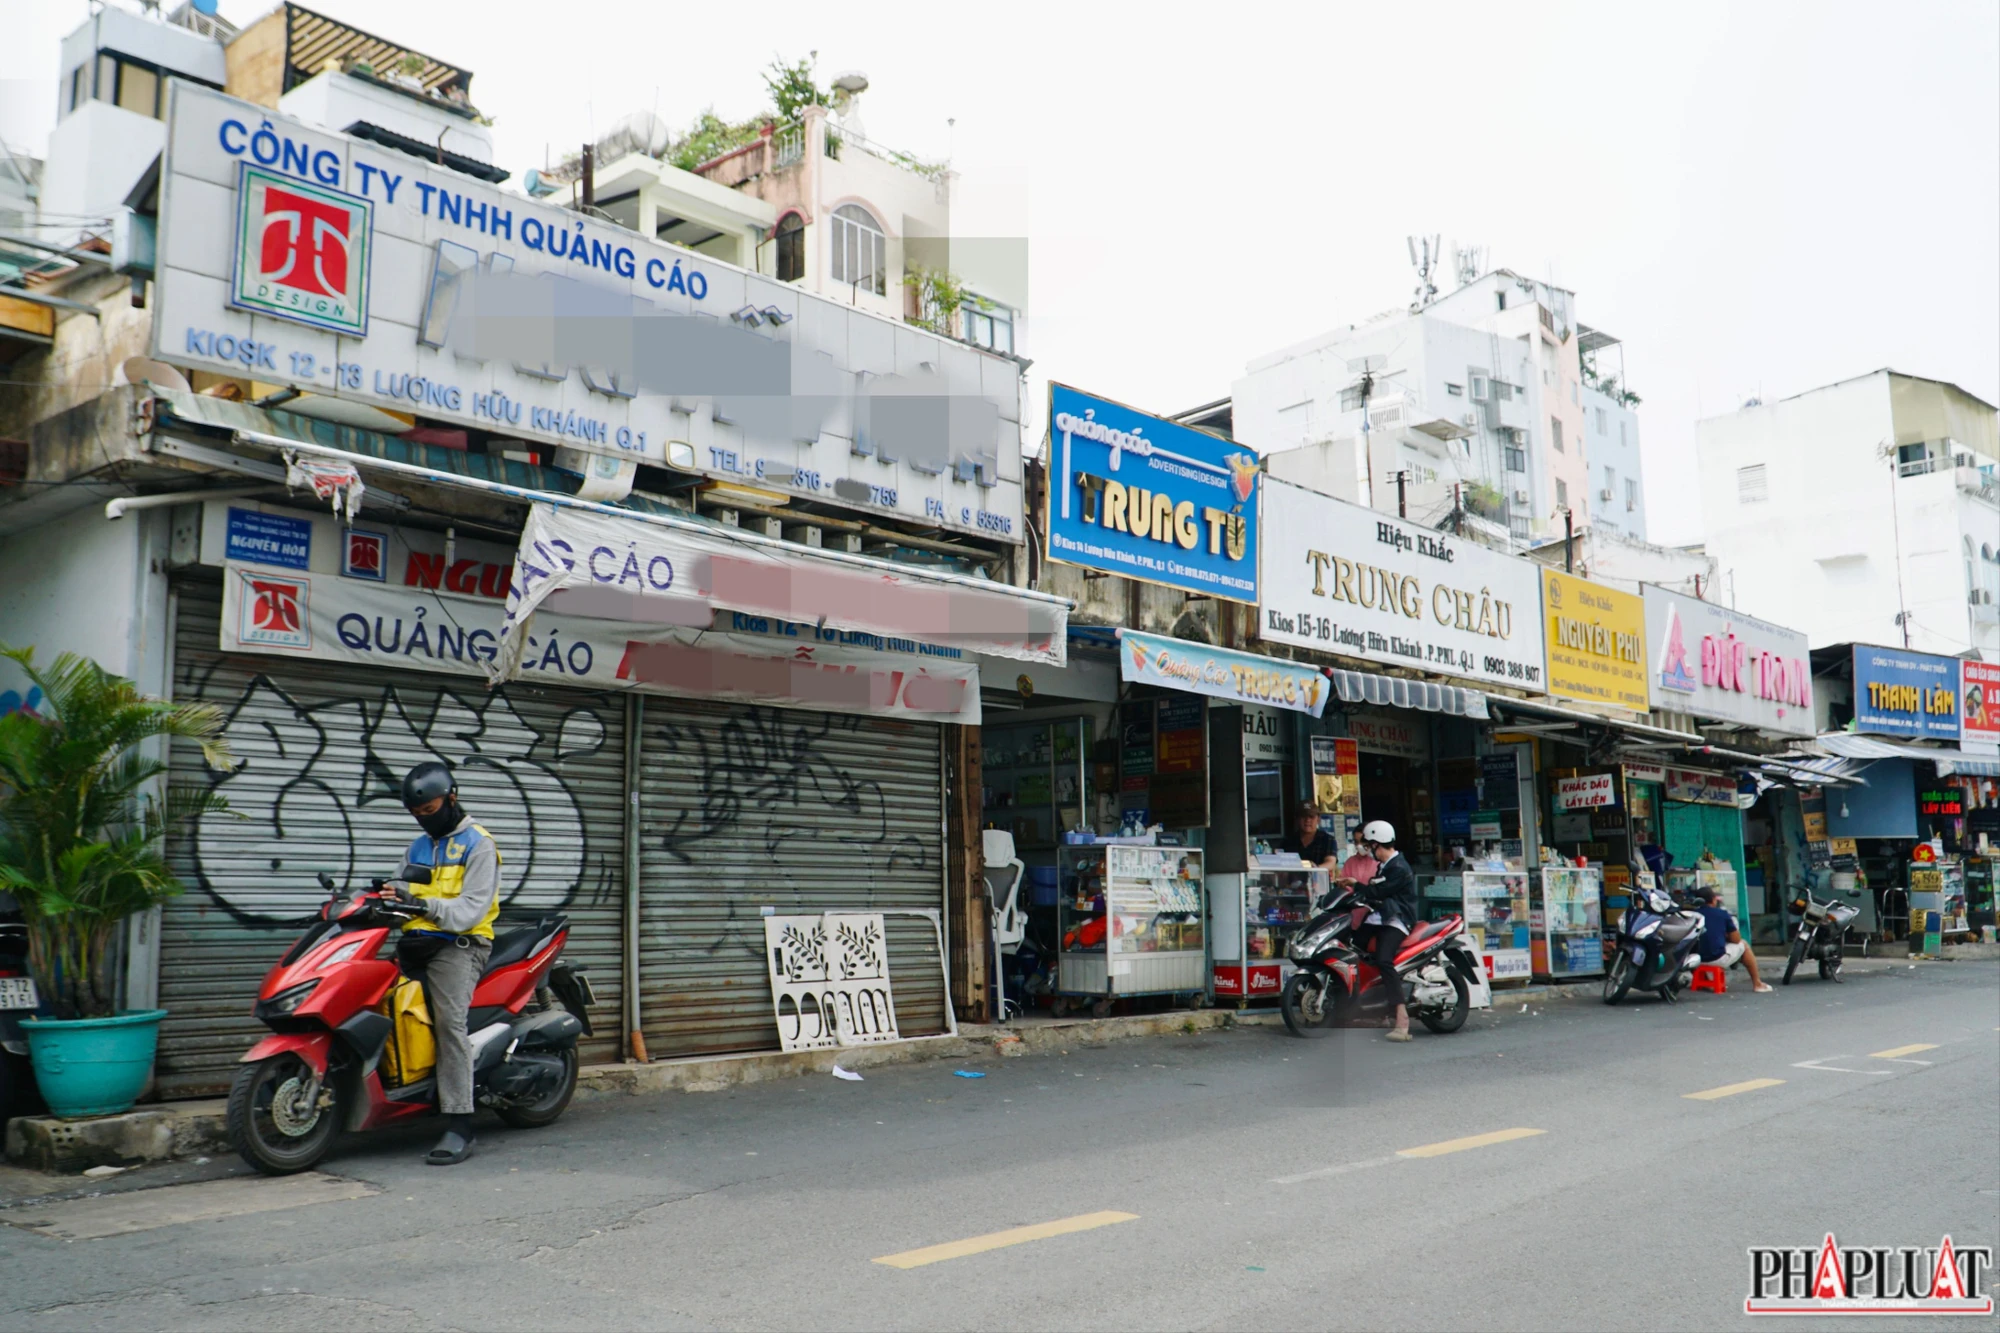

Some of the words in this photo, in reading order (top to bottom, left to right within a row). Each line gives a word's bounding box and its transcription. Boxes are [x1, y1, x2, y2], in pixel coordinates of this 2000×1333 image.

[218, 118, 340, 186] CÔNG
[354, 161, 404, 204] TY
[414, 181, 513, 241] TNHH
[520, 220, 636, 281] QUẢNG
[645, 257, 709, 301] CÁO
[256, 283, 347, 318] DESIGN
[185, 326, 277, 370] KIOSK
[288, 350, 316, 379] 12
[337, 361, 364, 389] 13
[374, 368, 462, 411] LƯƠNG
[472, 388, 523, 424] HỮU
[530, 407, 609, 444] KHÁNH
[616, 425, 649, 453] Q.1
[1076, 470, 1199, 551] TRUNG
[1202, 503, 1247, 562] TÚ
[1376, 521, 1413, 554] Hiệu
[1416, 535, 1455, 564] Khắc
[588, 541, 674, 594] CÁO
[1306, 548, 1424, 621] TRUNG
[1431, 585, 1513, 641] CHÂU
[337, 605, 499, 664] QUẢNG
[732, 612, 769, 634] Kios
[1268, 609, 1295, 634] Kios
[1297, 612, 1331, 641] 15-16
[1333, 623, 1366, 654] Lương
[1367, 630, 1389, 653] Hữu
[1390, 636, 1423, 660] Khánh
[1484, 655, 1506, 676] 0903
[1155, 650, 1201, 689] Quảng
[1203, 658, 1230, 687] Cáo
[1230, 663, 1297, 707] TRUNG
[1700, 622, 1746, 694] ĐỨC
[1243, 709, 1278, 737] HÂU
[1867, 681, 1921, 715] THANH
[1350, 720, 1377, 738] UNG
[1565, 793, 1583, 808] LẤY
[0, 979, 29, 993] 9-T2
